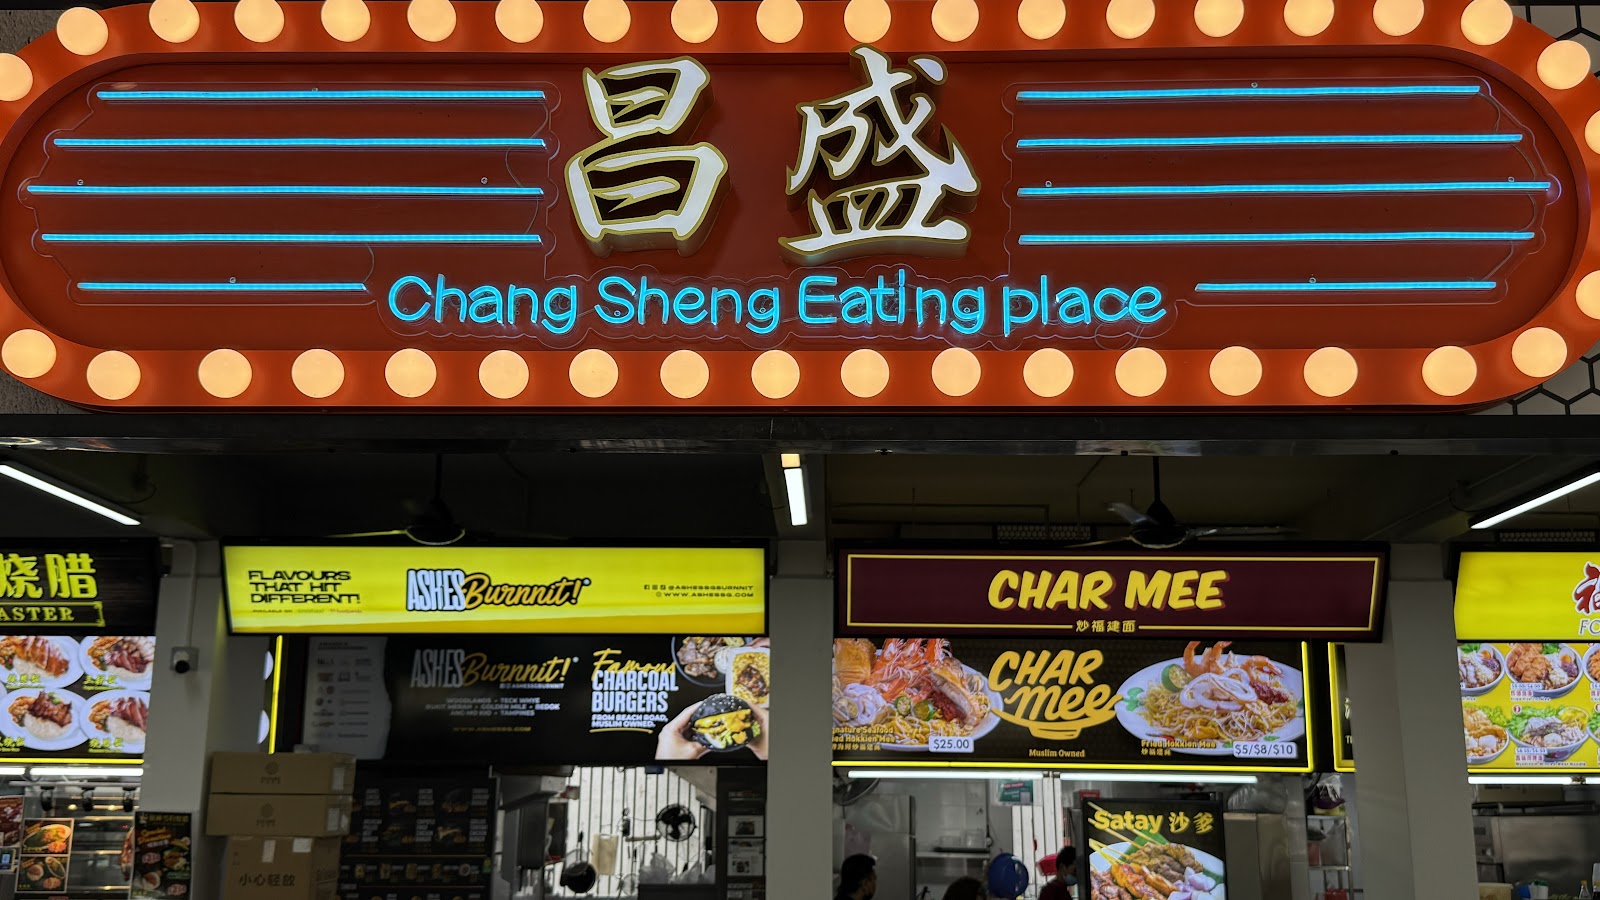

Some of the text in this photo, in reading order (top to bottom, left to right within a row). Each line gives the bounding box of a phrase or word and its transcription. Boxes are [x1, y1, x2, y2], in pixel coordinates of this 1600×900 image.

[388, 268, 1167, 338] Chang Sheng Eating place
[248, 570, 351, 580] FLAVOURS
[249, 582, 342, 592] THAT HIT
[407, 569, 583, 611] ASHES Burnnit!
[988, 569, 1229, 610] CHAR MEE
[251, 594, 361, 604] DIFFERENT!
[1076, 620, 1136, 633] 炒福建面
[410, 649, 572, 688] ASHES Burnnit!
[592, 648, 676, 682] Famous
[988, 649, 1104, 692] CHAR
[592, 670, 679, 691] CHARCOAL
[592, 691, 668, 713] BURGERS
[862, 726, 894, 734] Seafood
[846, 734, 878, 743] Hokkien
[879, 735, 896, 743] Mee
[933, 739, 970, 750] $25.00
[1141, 740, 1217, 748] Fried Hokkien Mee
[1029, 749, 1086, 758] Muslim Owned
[1235, 744, 1294, 756] $5/$8/$10
[1094, 810, 1164, 834] Satay
